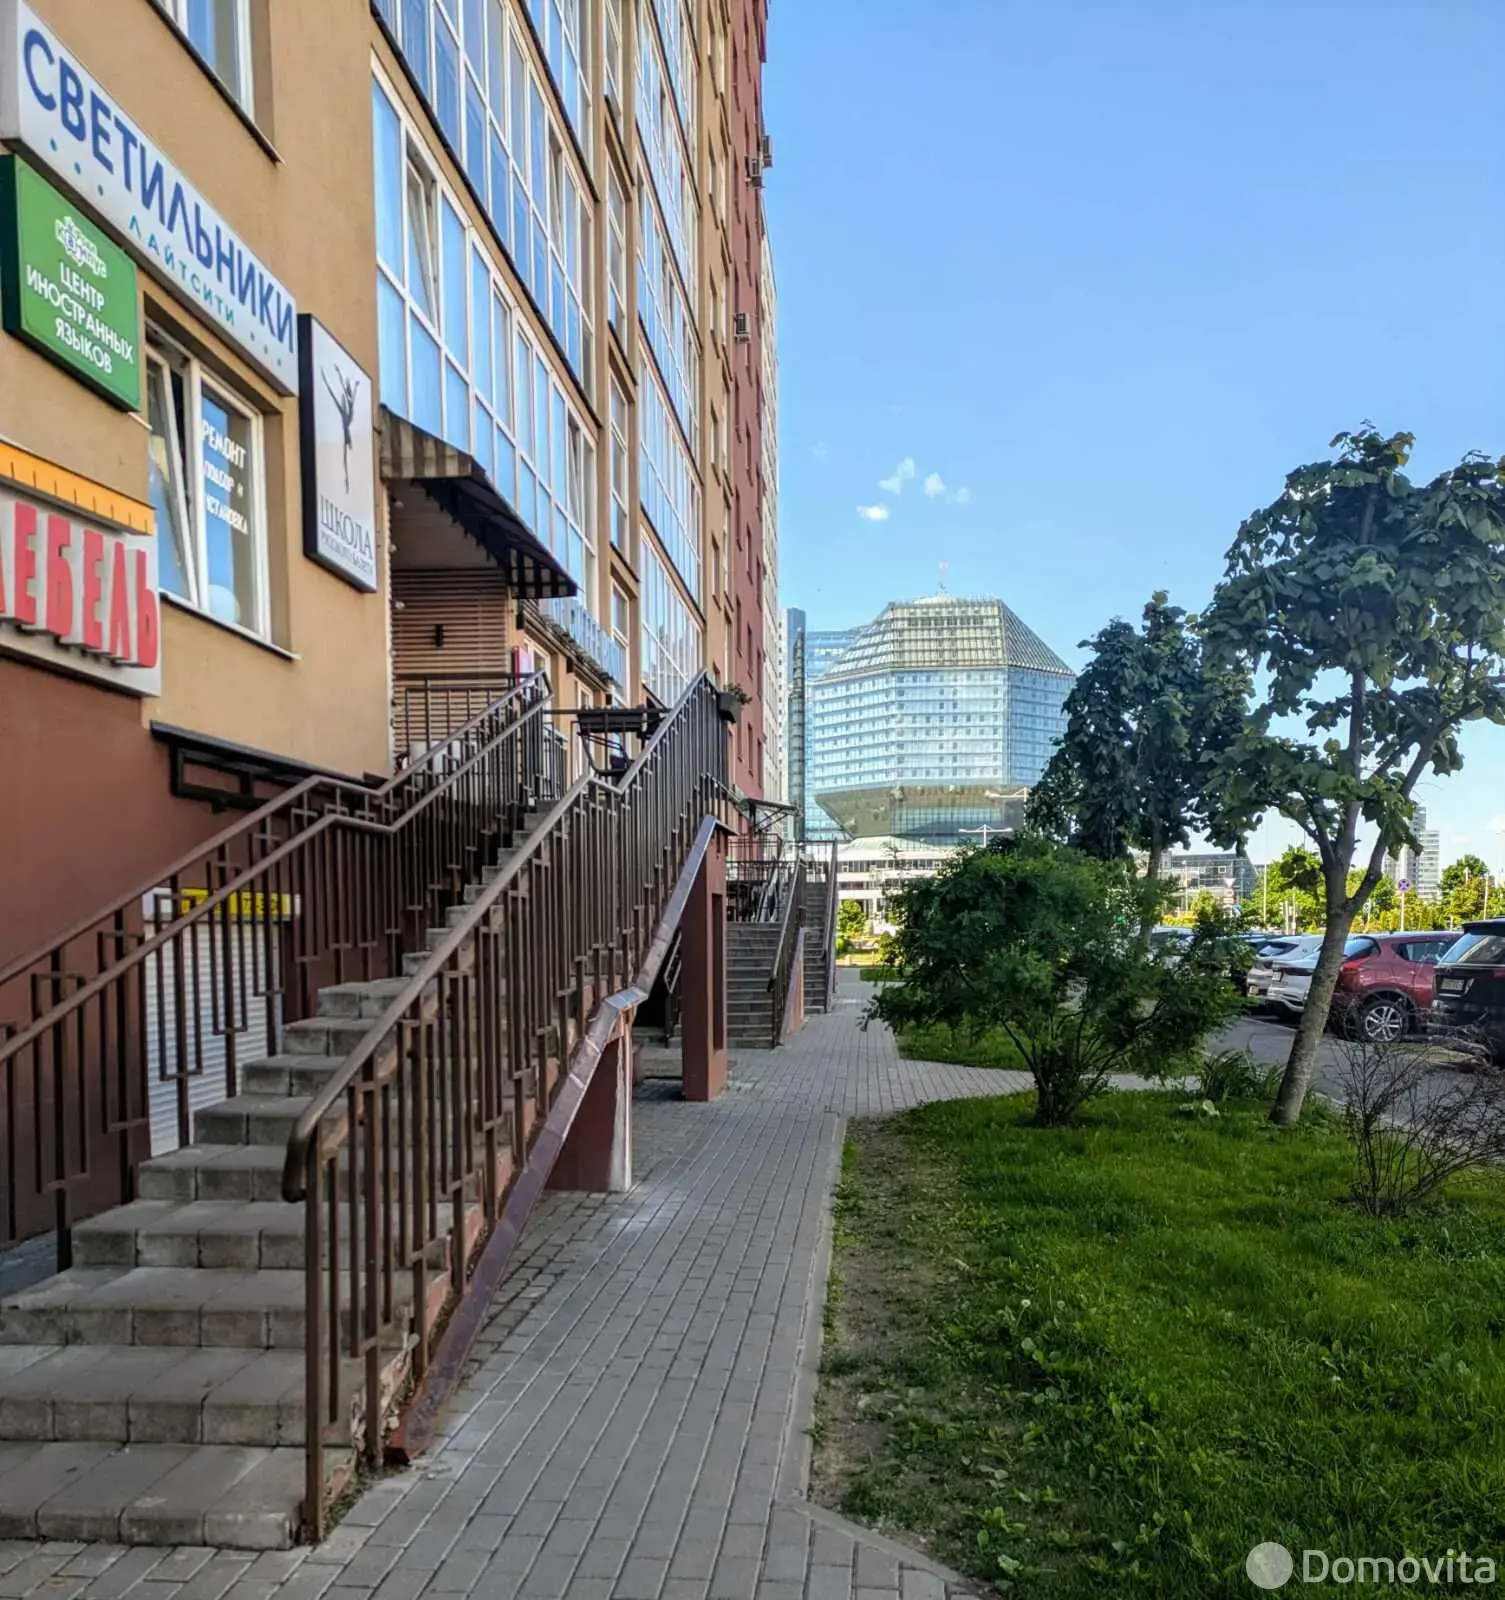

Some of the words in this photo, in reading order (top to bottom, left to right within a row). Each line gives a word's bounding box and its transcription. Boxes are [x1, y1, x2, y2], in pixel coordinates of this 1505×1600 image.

[24, 29, 294, 354] СВЕТИЛЬНИКИ
[26, 264, 134, 364] ИНОСТРАННЫХ
[60, 262, 105, 312] ЦЕНТР
[129, 215, 235, 326] ЛАЙТСИТИ
[55, 317, 112, 374] ЯЗЫКОВ
[320, 494, 373, 561] ШКОЛА
[0, 501, 158, 668] ЕБЕЛЬ
